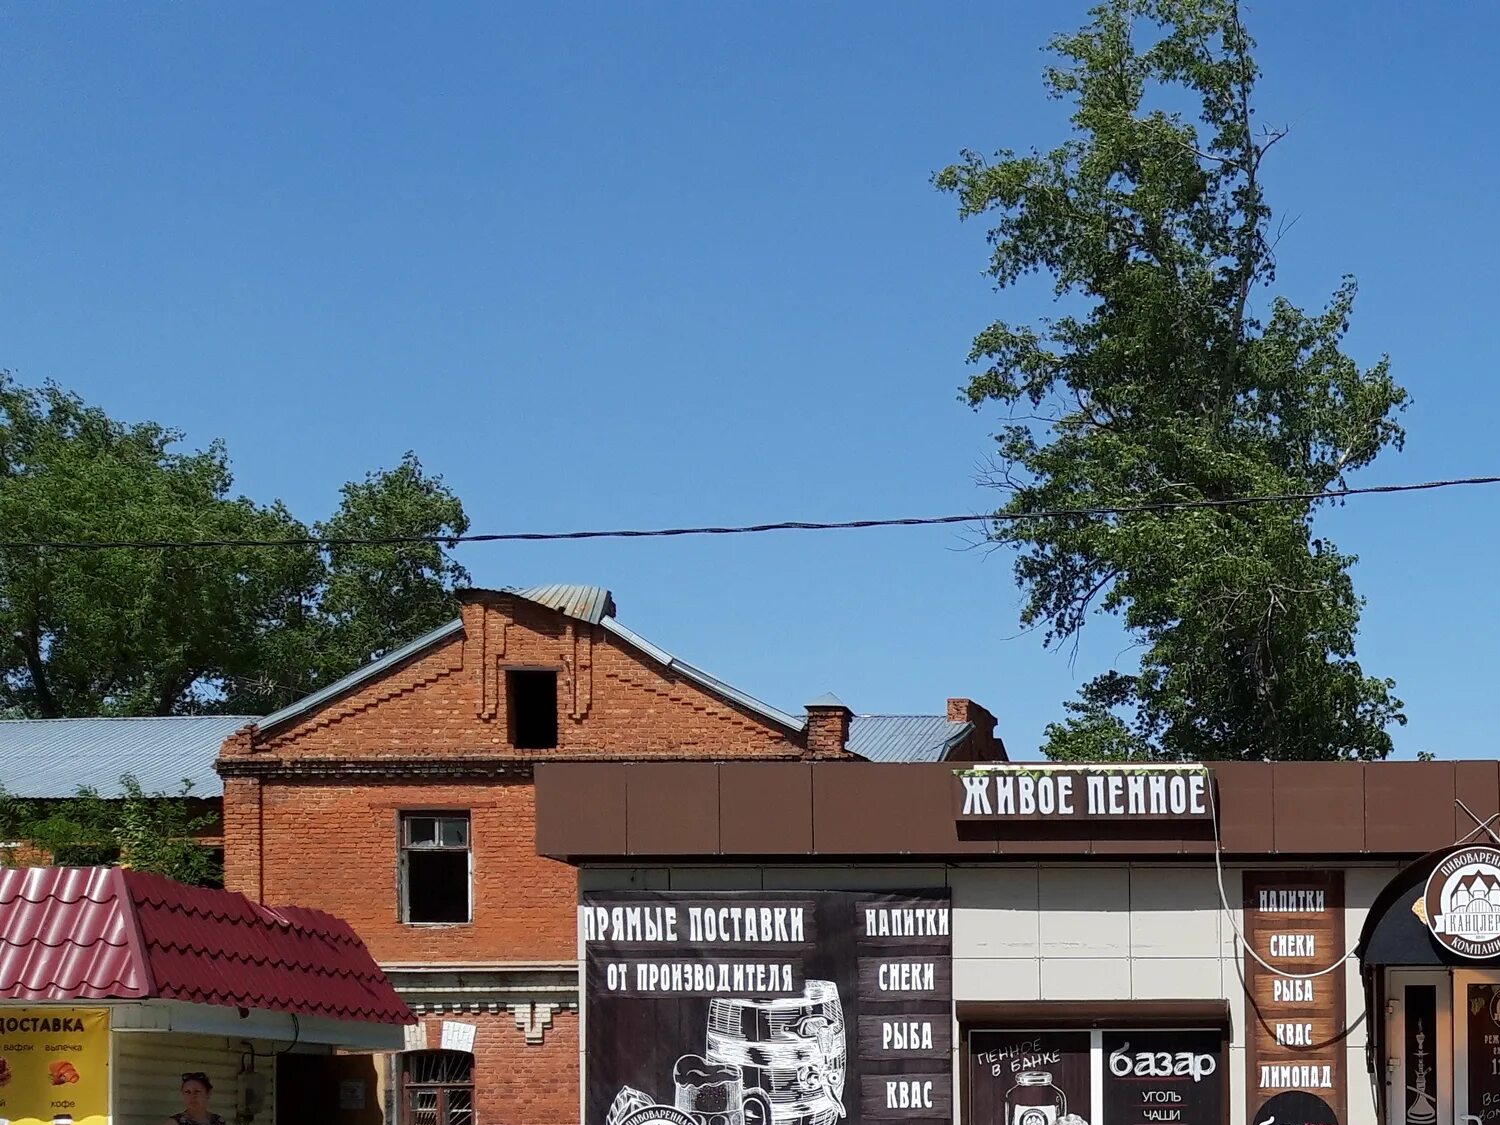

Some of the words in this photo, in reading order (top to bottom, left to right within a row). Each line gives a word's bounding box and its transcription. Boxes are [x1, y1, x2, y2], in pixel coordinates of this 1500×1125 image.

[962, 776, 1074, 815] ЖИВОЕ
[1087, 776, 1206, 815] ПЕННОЕ
[1259, 890, 1326, 912] НАПИТКИ
[584, 906, 678, 942] ПРЯМЫЕ
[688, 907, 805, 942] ПОСТАВКИ
[865, 908, 950, 936] НАПИТКИ
[1270, 935, 1315, 957] СНЕКИ
[607, 963, 628, 991] ОТ
[636, 963, 794, 993] ПРОИЗВОДИТЕЛЯ
[878, 963, 935, 991] СНЕКИ
[1273, 980, 1314, 1002] РЫБА
[882, 1022, 933, 1050] РЫБА
[1276, 1024, 1312, 1046] КВАС
[977, 1038, 1042, 1065] ПЕННОЕ
[992, 1063, 1001, 1077] В
[1011, 1048, 1061, 1072] БАНКЕ
[1109, 1042, 1215, 1082] базар
[1259, 1066, 1332, 1089] ЛИМОНАД
[51, 1100, 76, 1109] кофе
[886, 1081, 933, 1109] КВАС
[1142, 1091, 1182, 1102] УГОЛЬ
[1143, 1110, 1181, 1121] ЧАШИ
